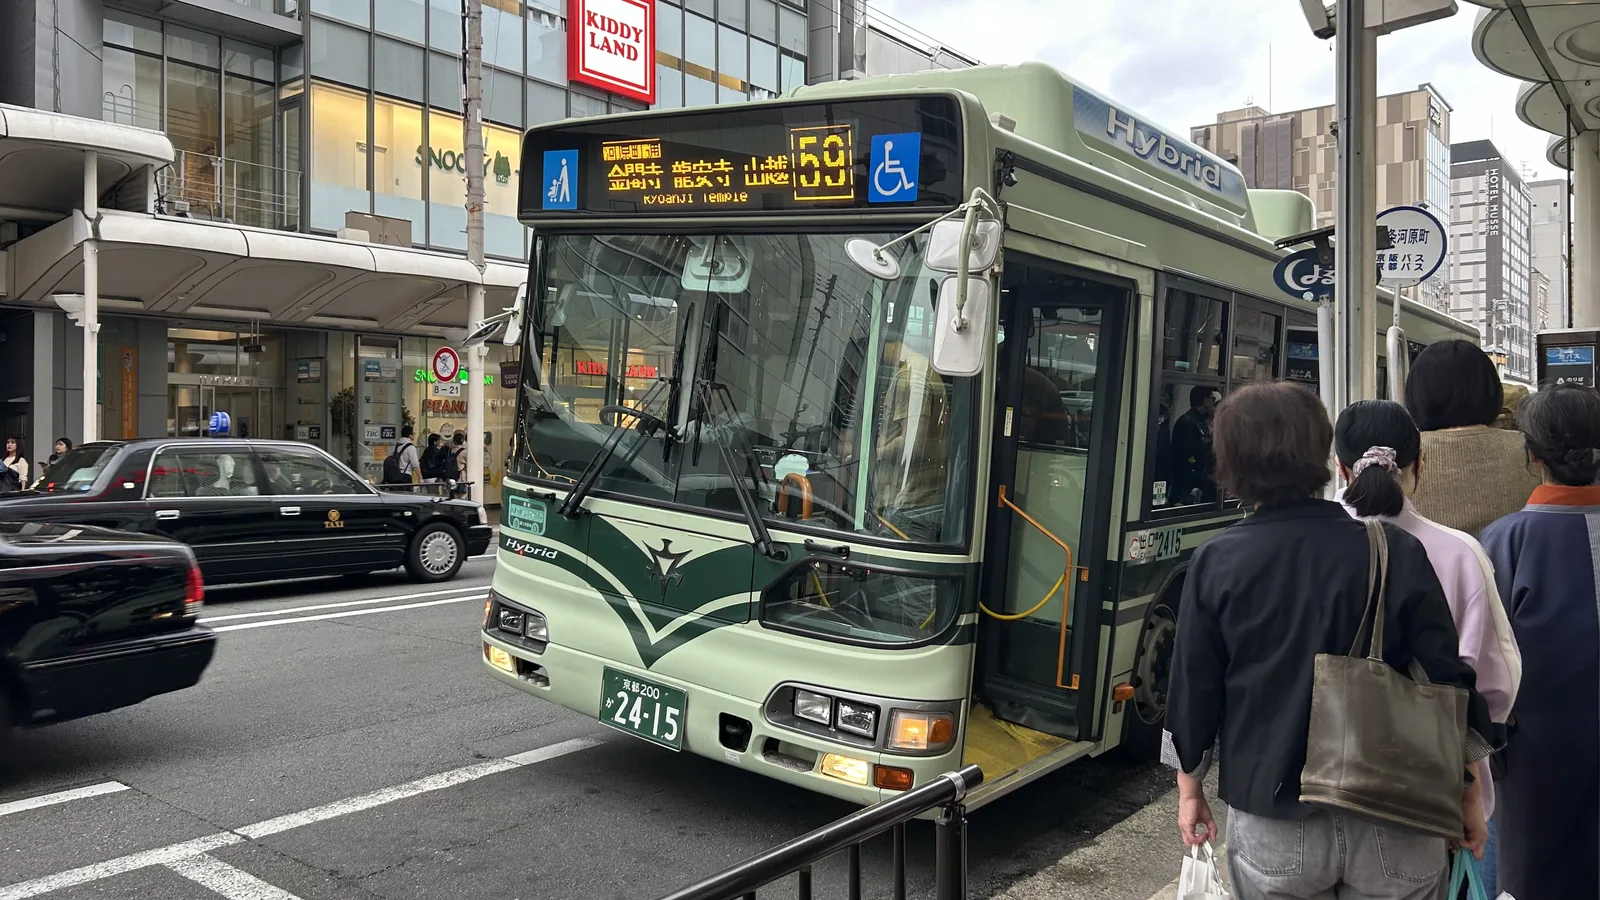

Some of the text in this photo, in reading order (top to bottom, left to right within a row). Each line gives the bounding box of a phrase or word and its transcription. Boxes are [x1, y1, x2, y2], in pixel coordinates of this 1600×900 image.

[586, 9, 644, 44] KIDDY
[589, 32, 639, 62] LAND
[799, 134, 846, 188] 59
[1106, 106, 1221, 191] Hybrid
[608, 162, 664, 191] 金閣寺
[671, 158, 734, 189] 龍安寺
[703, 192, 748, 204] Temple
[1489, 168, 1499, 236] HOTEL MUSSE
[1388, 228, 1430, 245] 条河原町
[1376, 253, 1425, 263] 京阪バス
[421, 398, 468, 415] PEANU
[323, 520, 345, 529] TAXI
[506, 538, 558, 560] Hybrid
[1139, 533, 1154, 550] 出口
[1156, 528, 1182, 558] 2415
[605, 690, 680, 741] か 24-15
